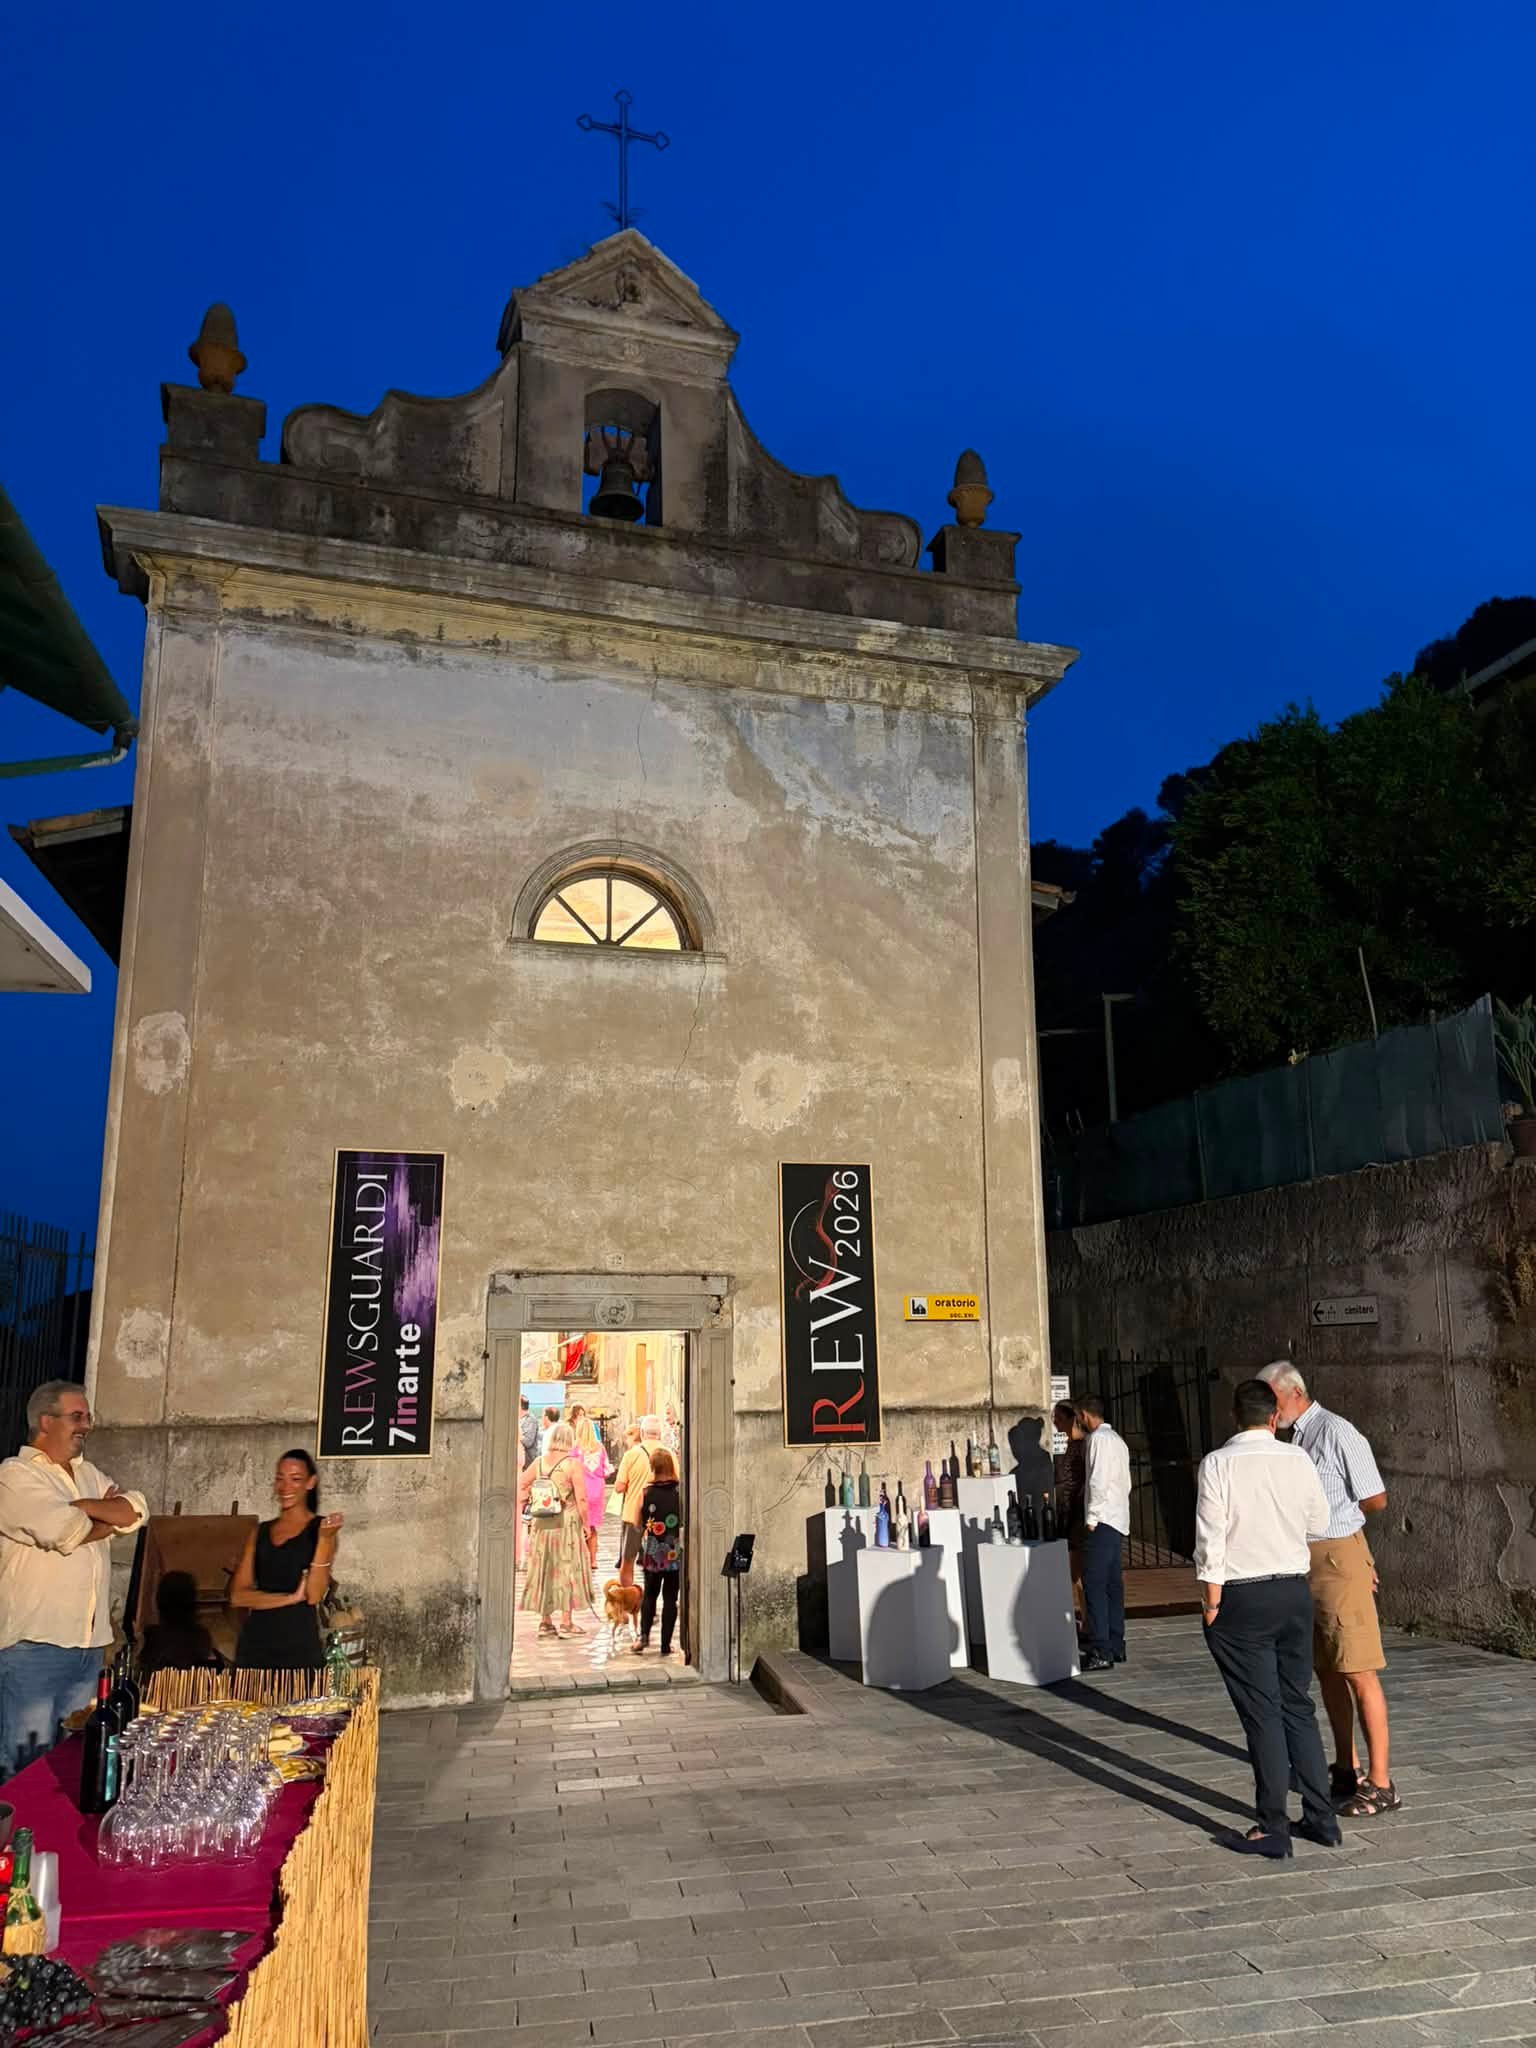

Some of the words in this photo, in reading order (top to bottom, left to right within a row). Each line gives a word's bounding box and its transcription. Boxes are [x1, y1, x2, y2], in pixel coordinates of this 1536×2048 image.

[832, 1170, 861, 1257] 2026
[809, 1256, 866, 1436] REW
[935, 1298, 976, 1307] oratorio
[388, 1322, 421, 1447] 7inarte
